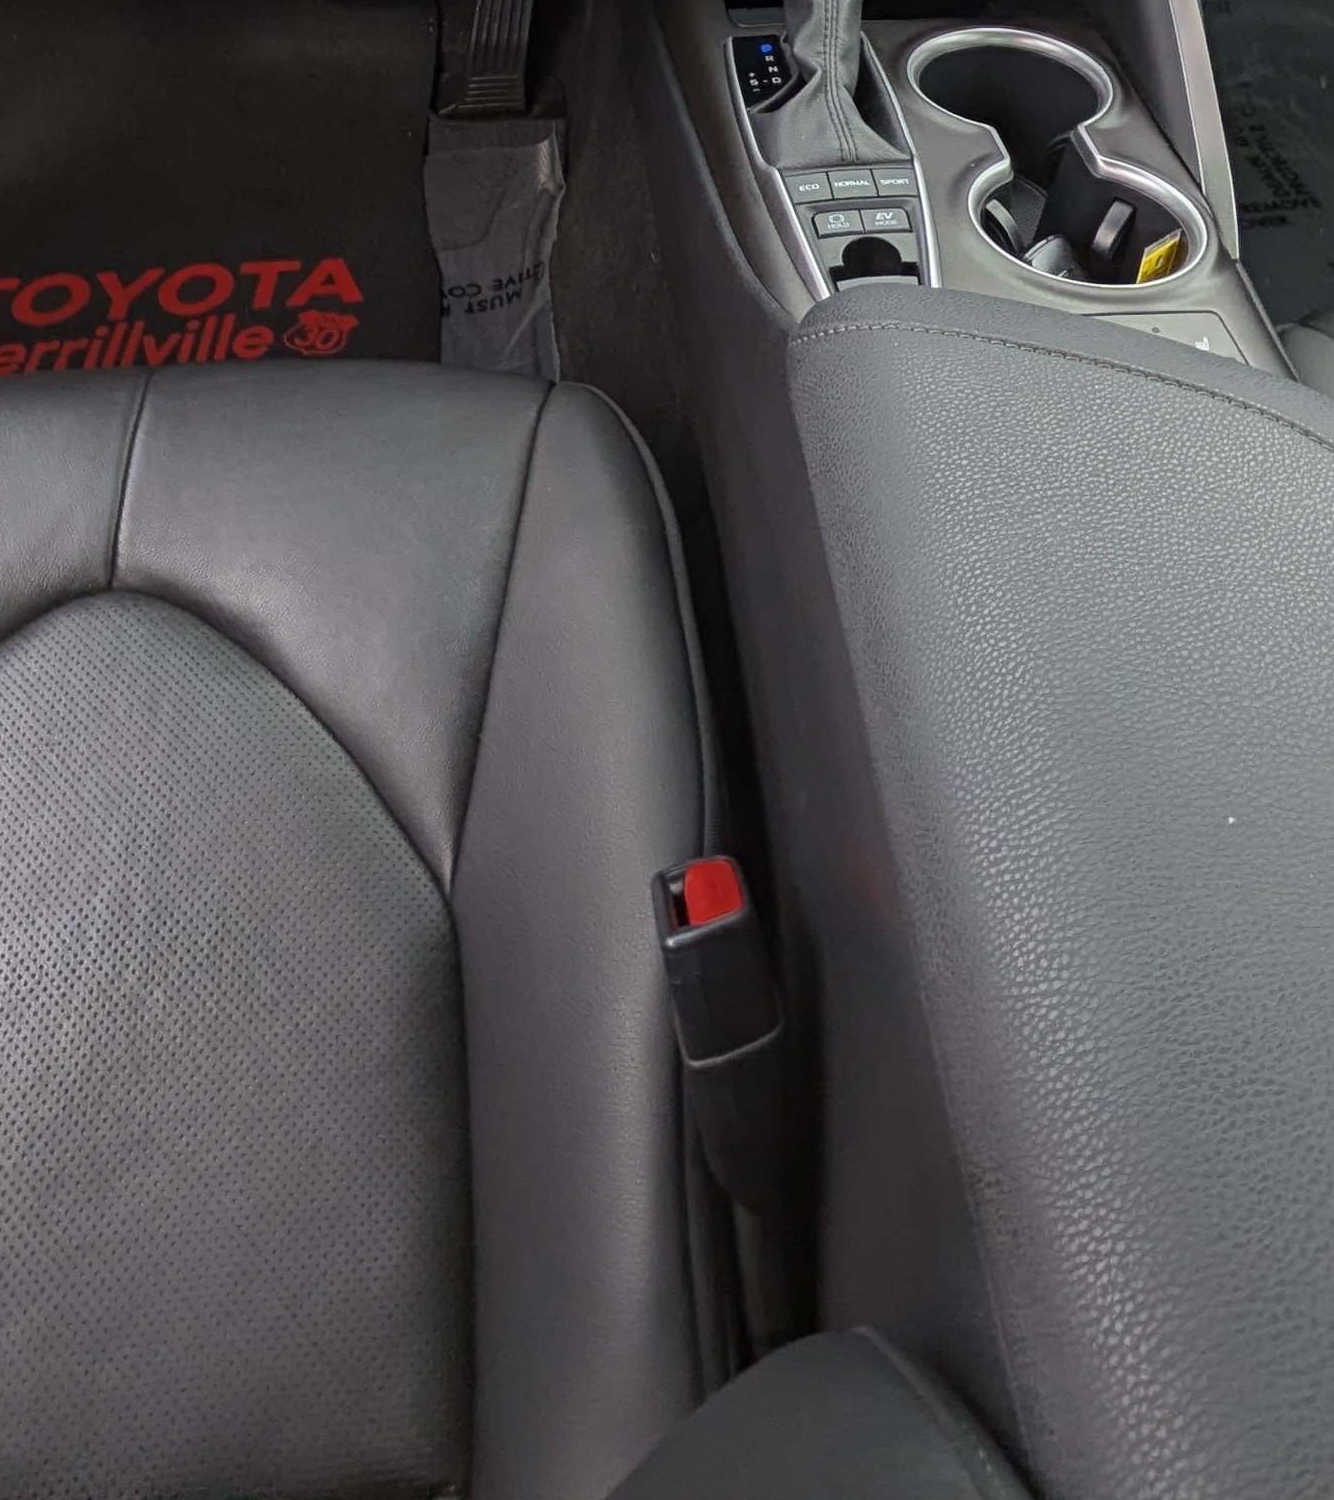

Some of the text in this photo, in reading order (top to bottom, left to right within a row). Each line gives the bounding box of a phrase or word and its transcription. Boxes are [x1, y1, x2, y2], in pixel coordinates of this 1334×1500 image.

[799, 178, 910, 192] ECO NORMAL SPORT
[876, 212, 894, 220] EV
[294, 329, 339, 350] 30
